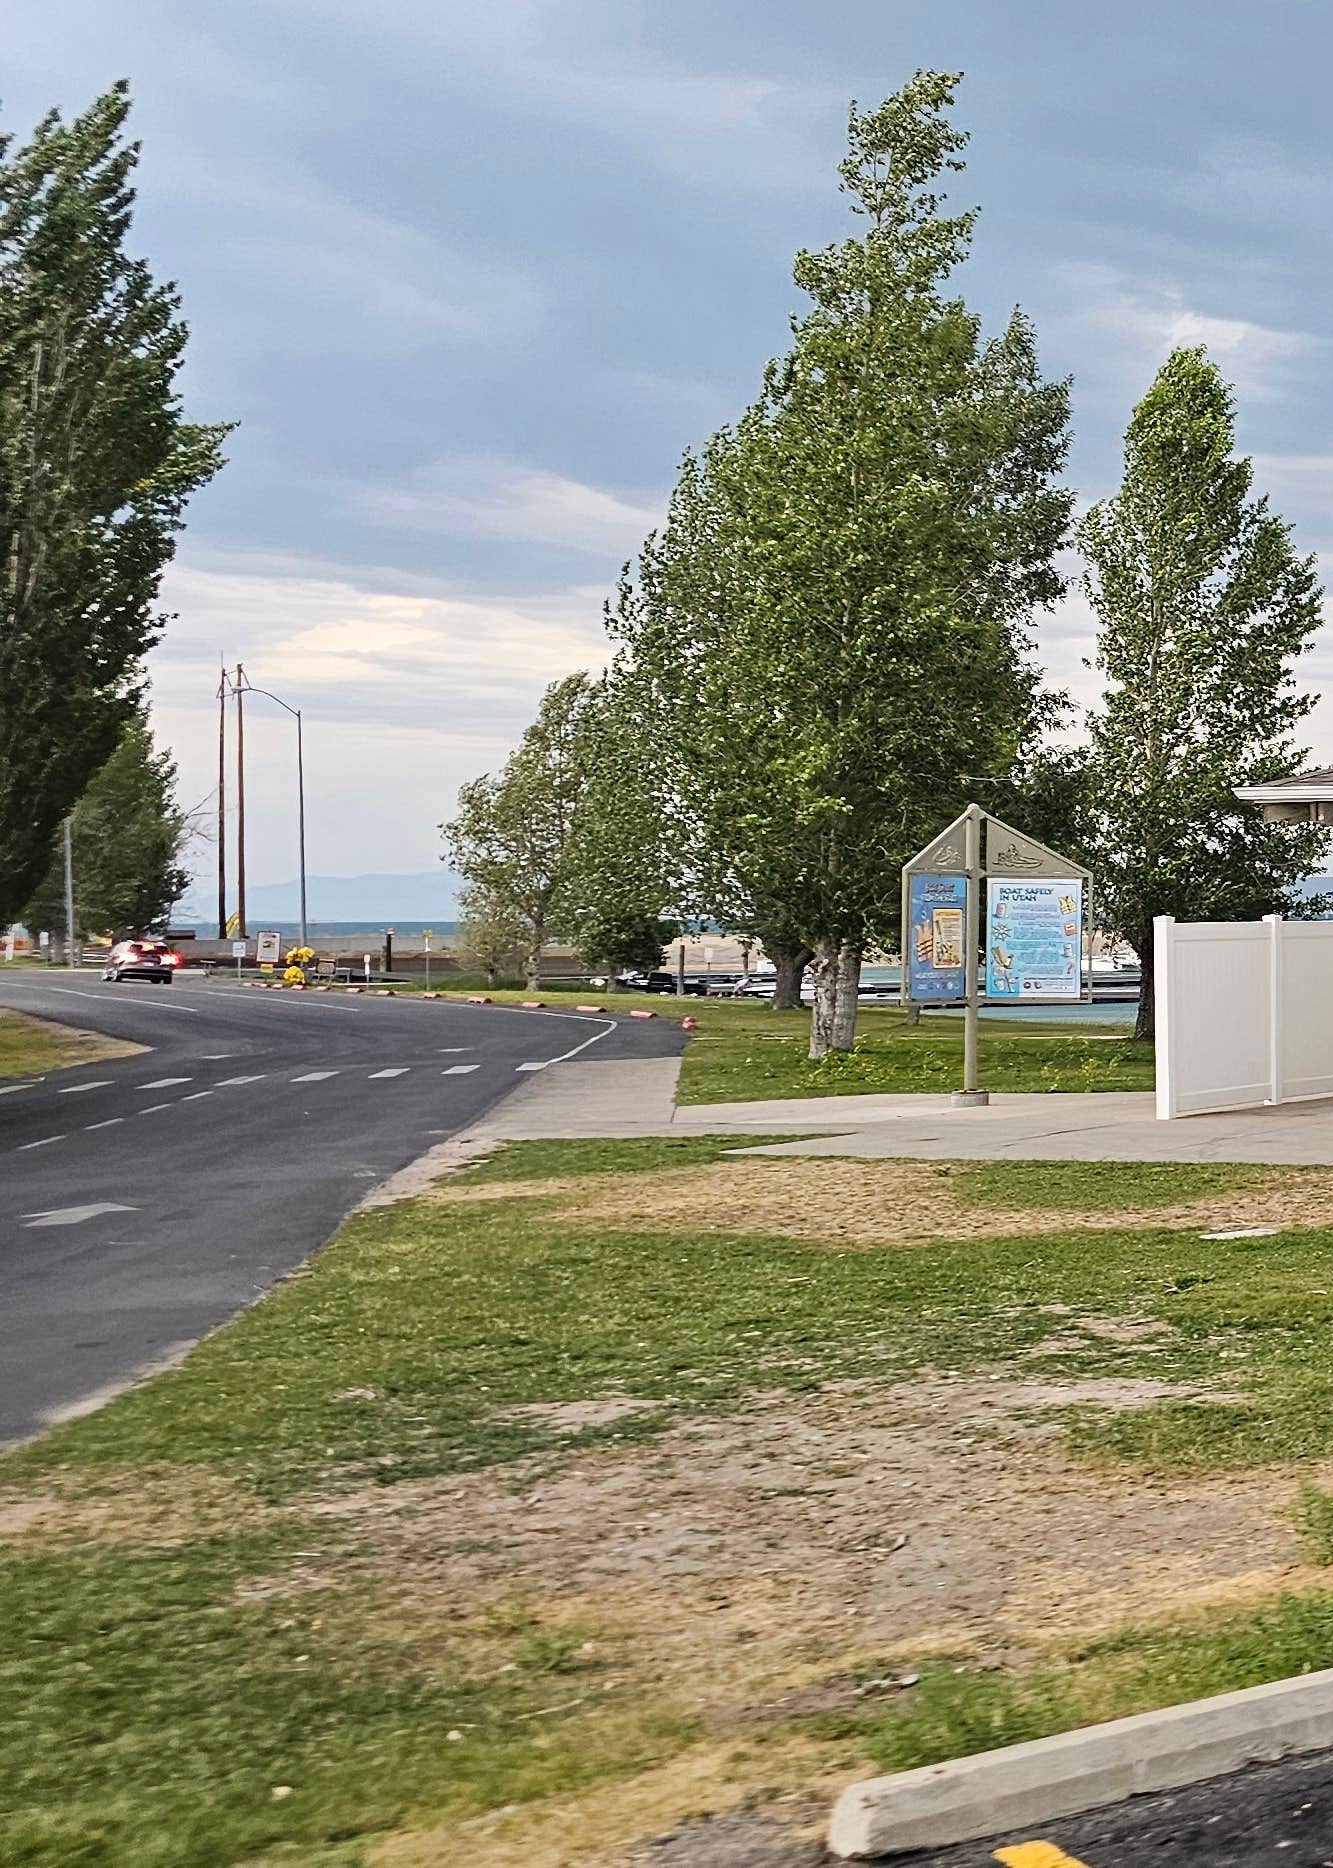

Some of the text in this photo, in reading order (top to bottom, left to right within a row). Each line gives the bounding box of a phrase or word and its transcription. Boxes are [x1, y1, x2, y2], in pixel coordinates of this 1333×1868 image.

[999, 887, 1054, 895] BOAT SAFELY
[1012, 894, 1037, 902] UTAH
